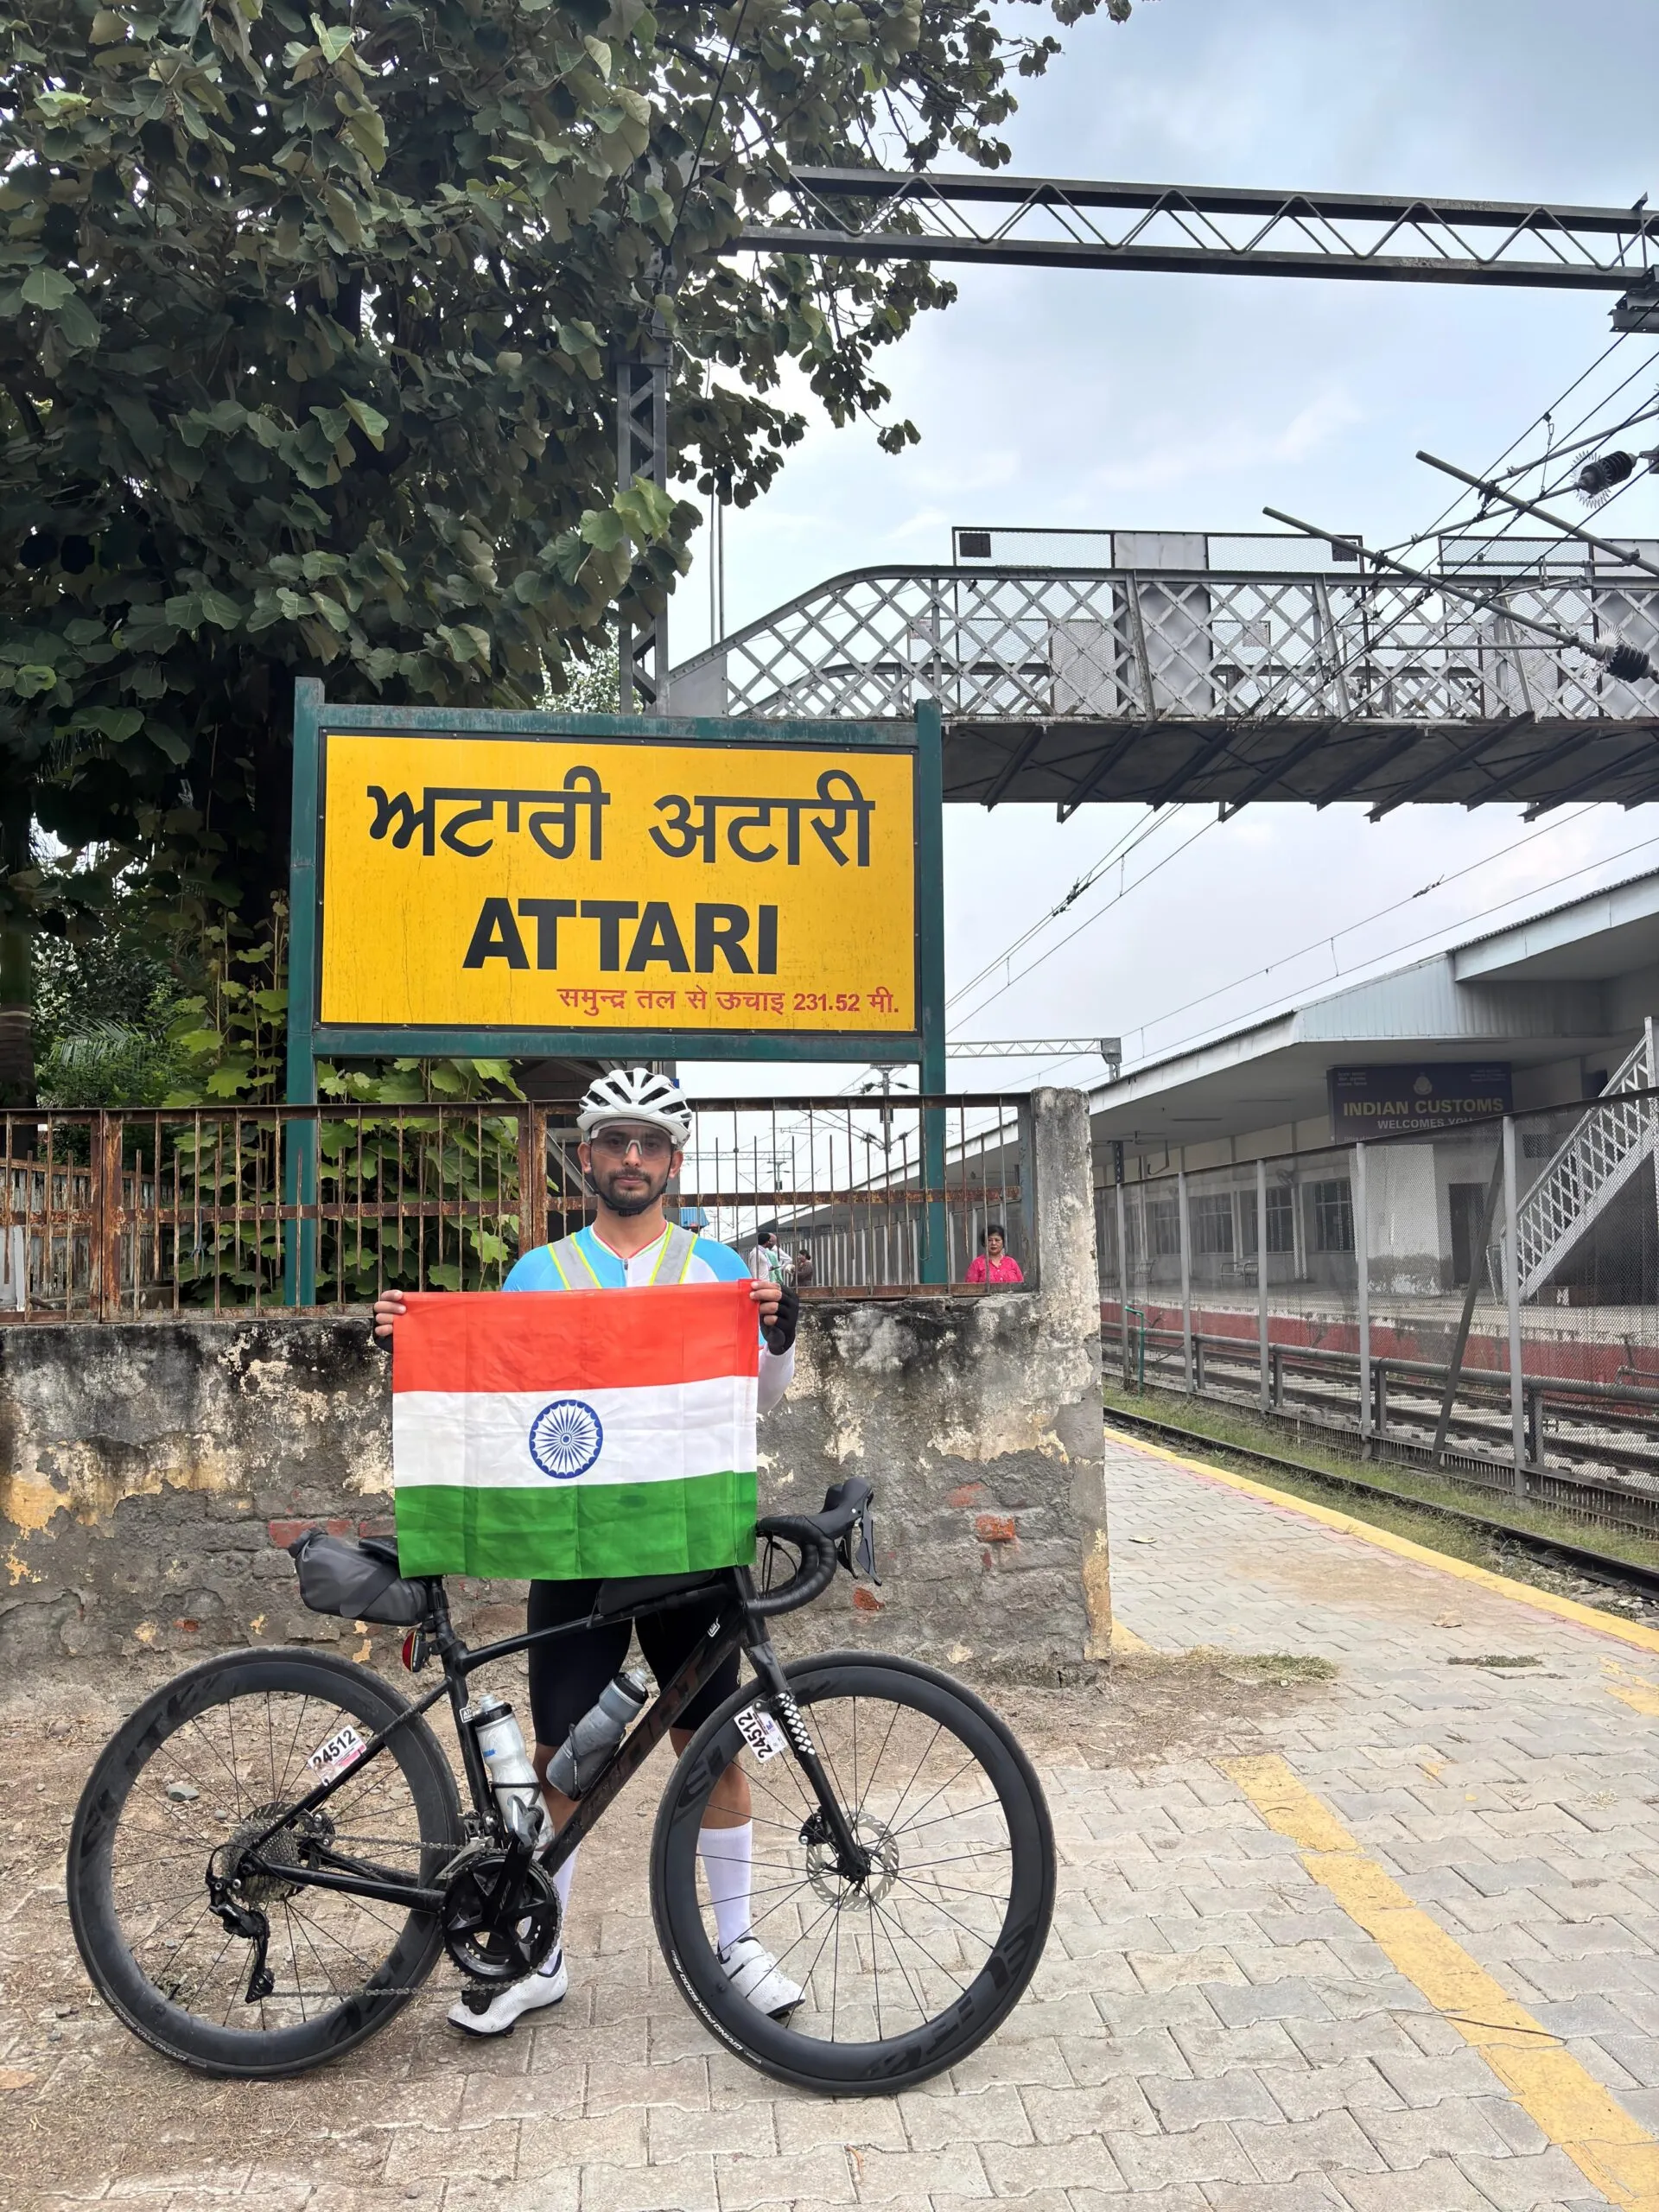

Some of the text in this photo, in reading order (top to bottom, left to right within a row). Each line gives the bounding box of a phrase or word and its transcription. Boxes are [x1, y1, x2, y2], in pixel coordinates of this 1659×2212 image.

[367, 766, 611, 861] ਅਟਾਰੀ
[648, 769, 876, 867] अटारी
[462, 897, 779, 975] ATTARI
[556, 988, 628, 1016] समुन्द्र
[634, 990, 677, 1010] तल
[684, 985, 708, 1010] से
[793, 993, 861, 1012] 231.52
[867, 986, 899, 1013] मी.
[1344, 1098, 1504, 1116] INDIAN CUSTOMS
[1377, 1118, 1445, 1130] WELCOMES
[313, 1730, 356, 1765] 24512
[738, 1712, 773, 1758] 24512
